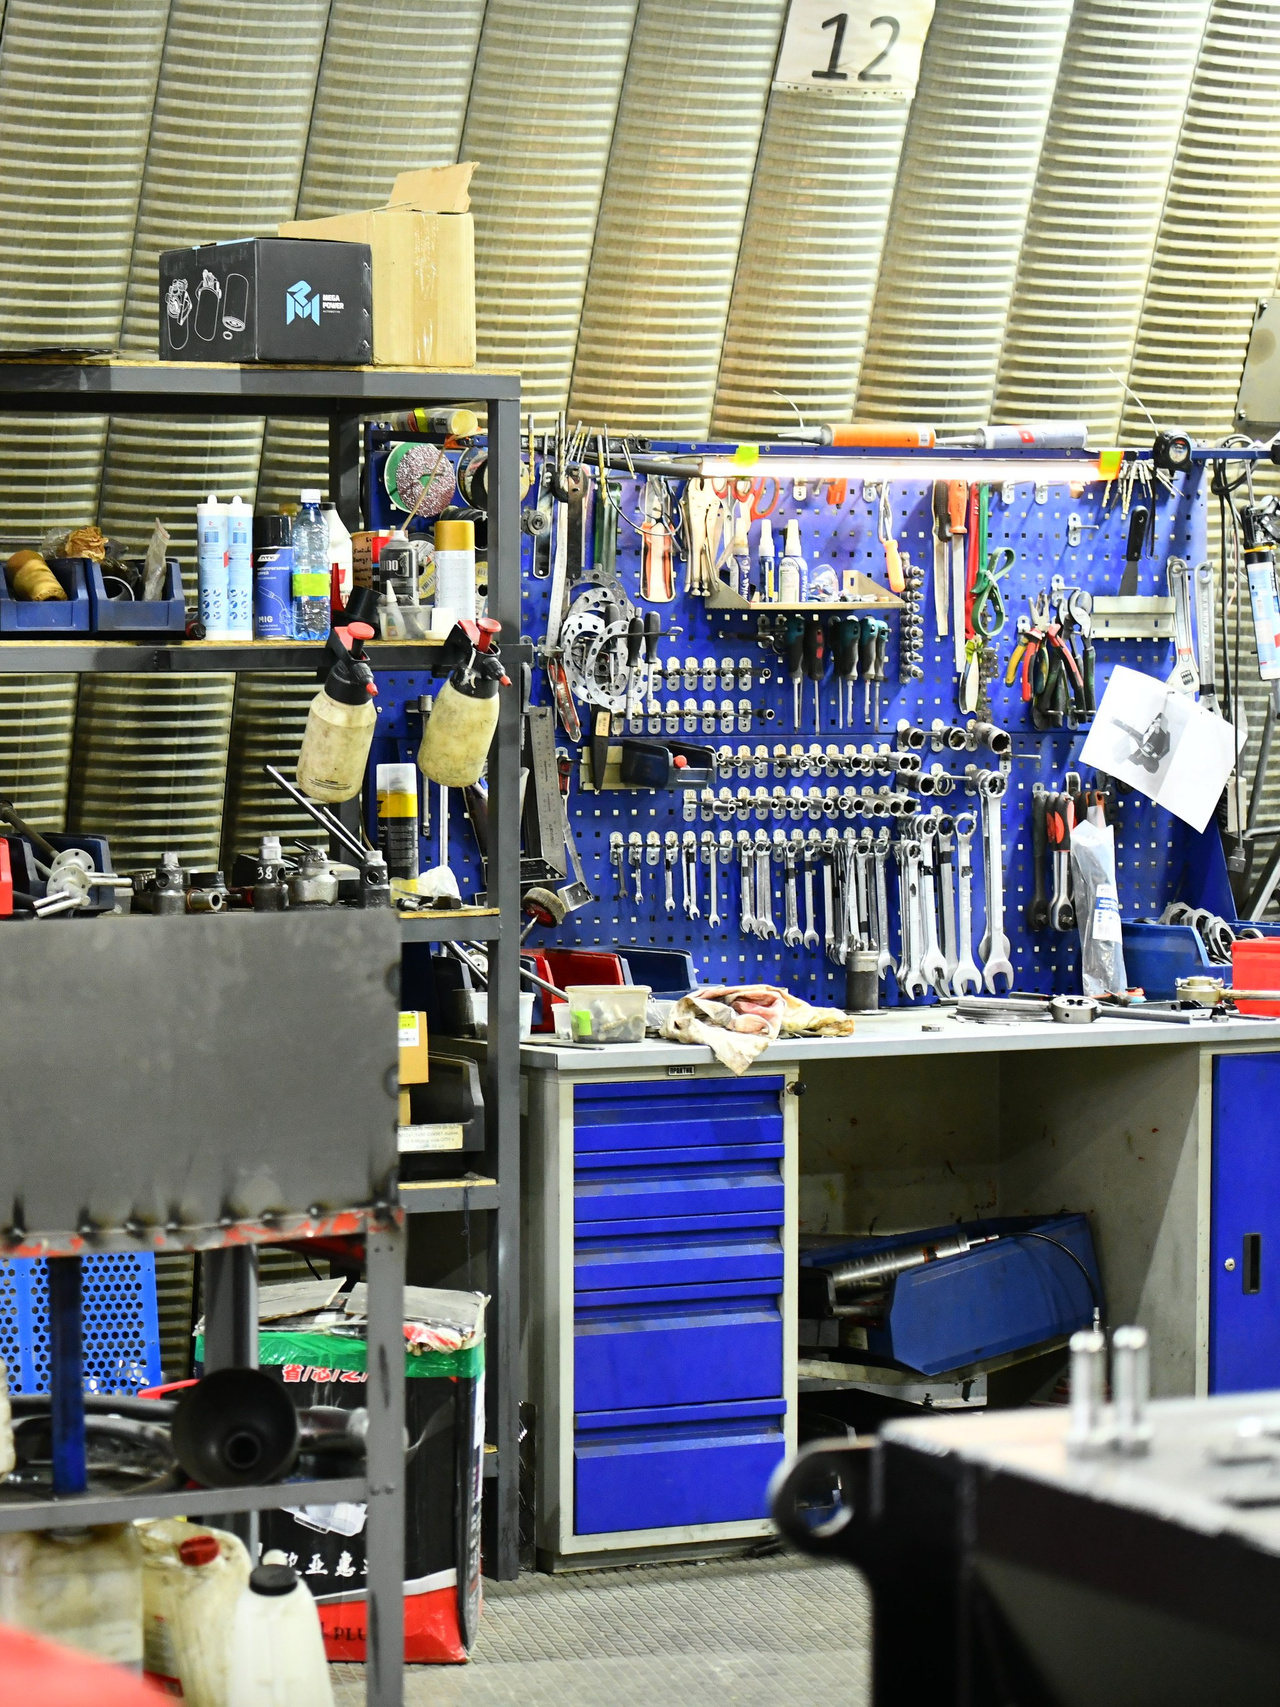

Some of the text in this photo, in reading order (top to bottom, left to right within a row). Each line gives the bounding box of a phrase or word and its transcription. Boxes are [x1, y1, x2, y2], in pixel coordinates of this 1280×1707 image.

[811, 13, 900, 82] 12
[322, 294, 341, 302] MEGA
[322, 302, 345, 310] POWER
[258, 615, 274, 623] MIG
[257, 866, 273, 880] 38
